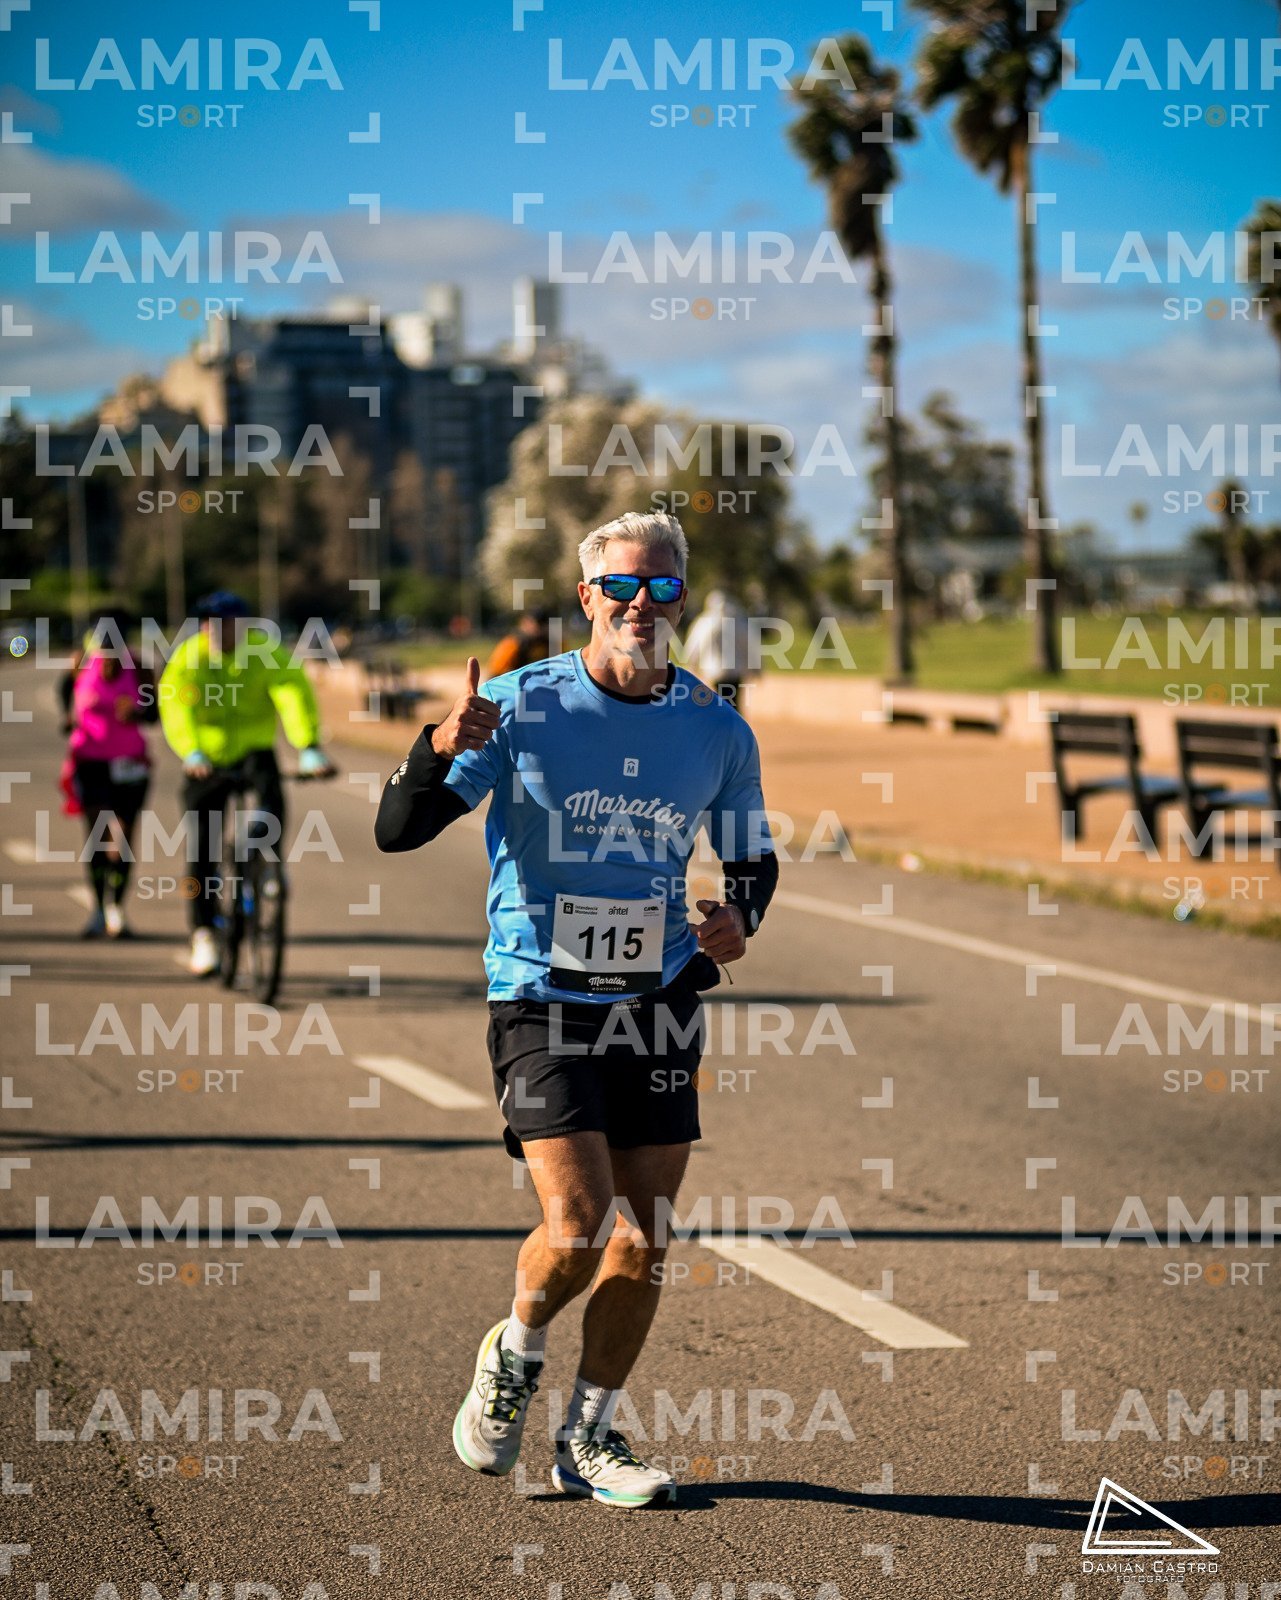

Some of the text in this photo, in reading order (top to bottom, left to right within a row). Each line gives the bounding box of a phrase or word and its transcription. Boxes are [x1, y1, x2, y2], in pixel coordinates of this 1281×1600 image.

[564, 788, 687, 830] Maratón
[573, 824, 672, 841] MONTEVIDEO
[608, 905, 629, 916] antel
[578, 926, 644, 960] 115
[588, 976, 627, 987] Maratón
